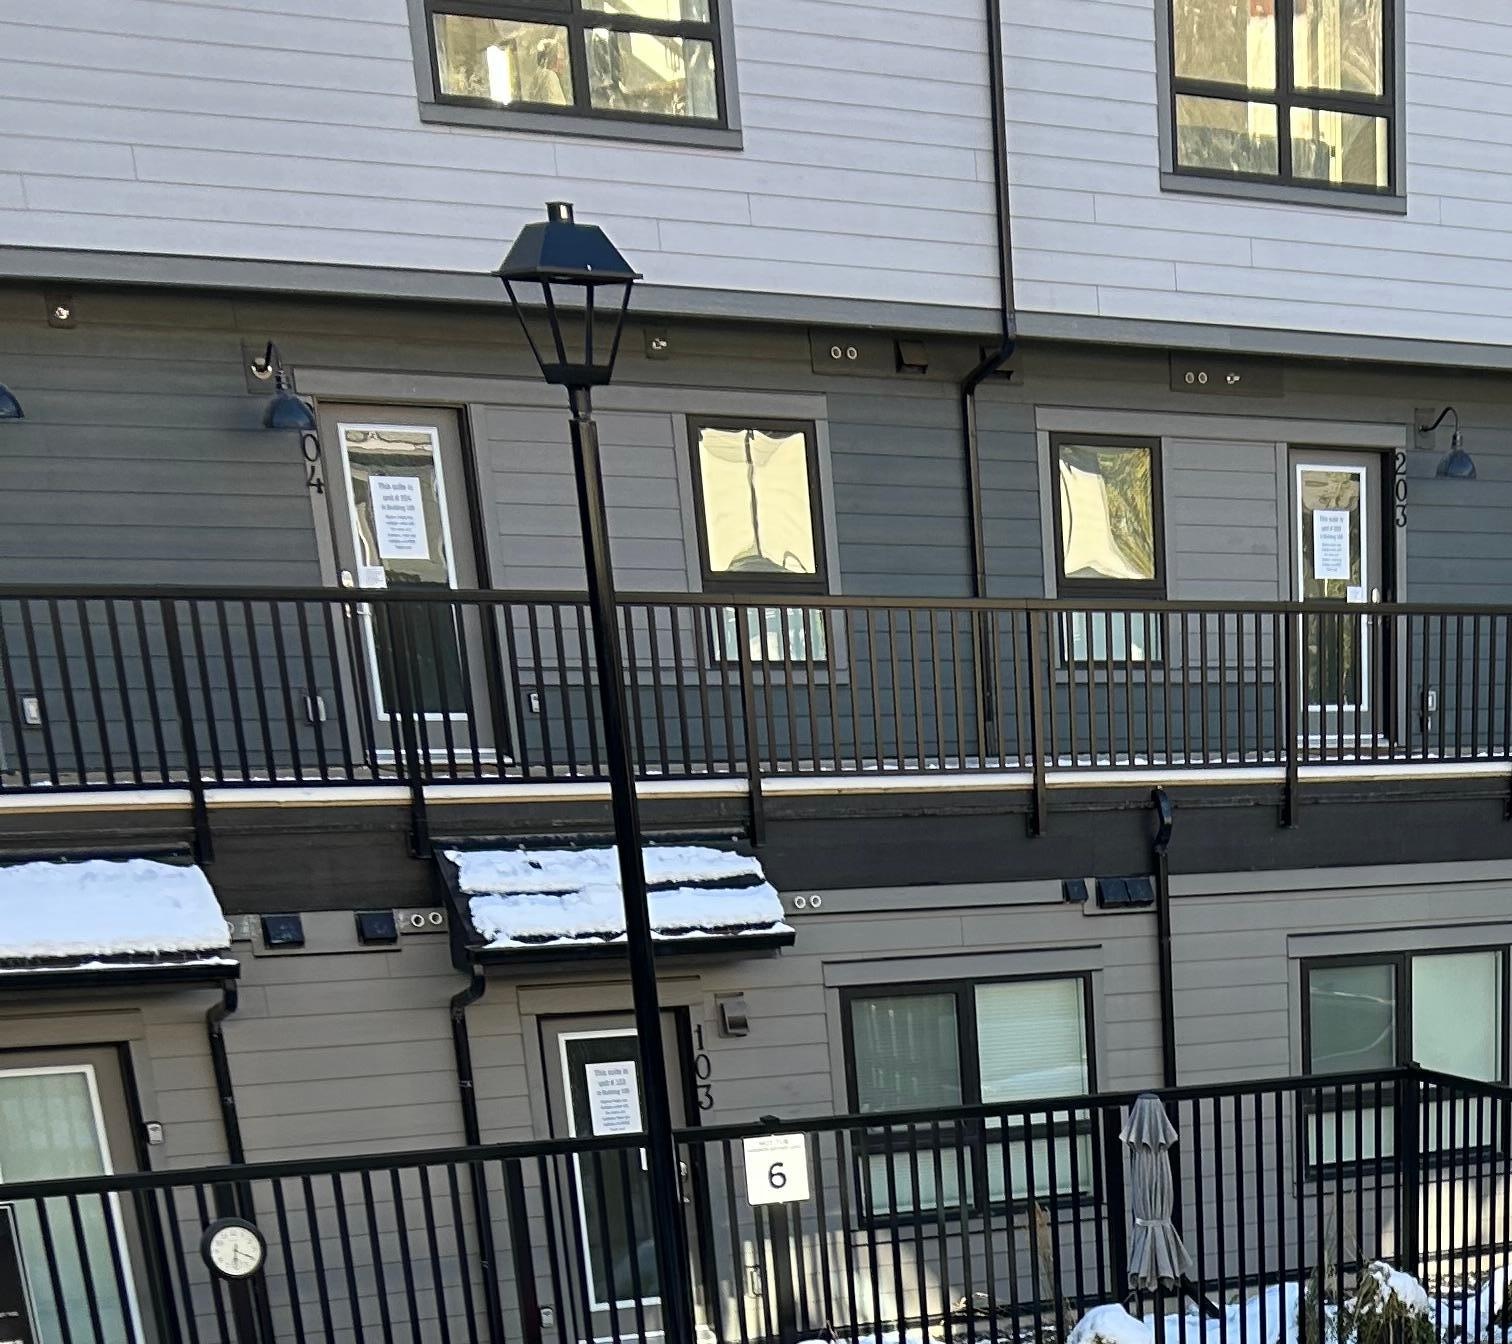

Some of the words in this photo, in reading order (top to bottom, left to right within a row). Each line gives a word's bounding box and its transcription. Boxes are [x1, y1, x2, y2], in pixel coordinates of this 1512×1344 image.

[1395, 452, 1408, 528] 203
[694, 1024, 714, 1111] 103
[768, 1162, 787, 1189] 6
